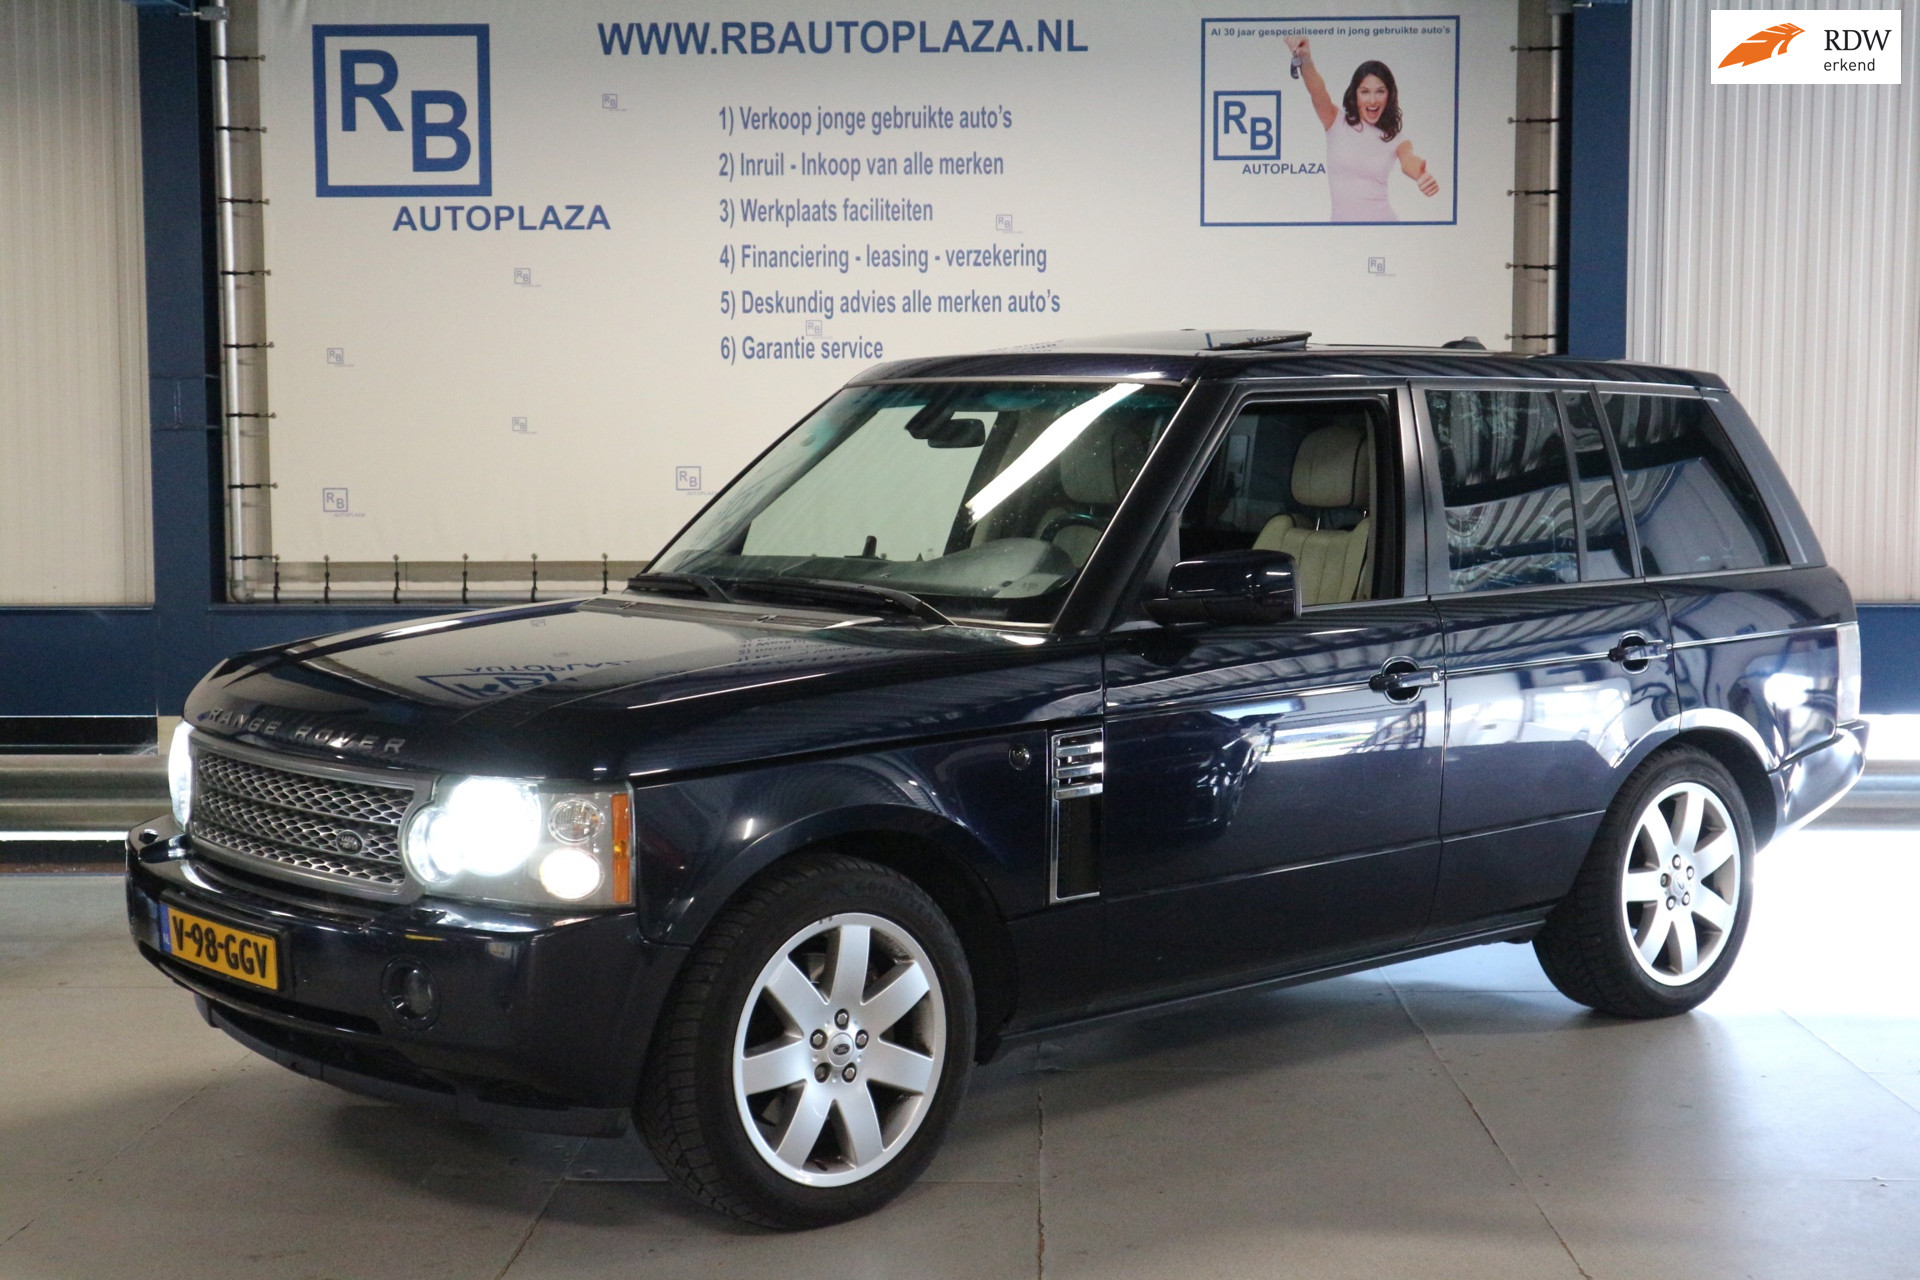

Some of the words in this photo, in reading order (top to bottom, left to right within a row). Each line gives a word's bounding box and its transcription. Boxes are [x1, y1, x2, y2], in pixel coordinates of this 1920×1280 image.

[597, 19, 1088, 55] WWW.RBAUTOPLAZA.NL
[1211, 28, 1221, 36] Al
[1223, 28, 1235, 36] 30
[1237, 28, 1255, 37] jaar
[1258, 27, 1334, 38] gespecialiseerd
[1337, 27, 1346, 35] in
[1348, 27, 1370, 36] jong
[1372, 25, 1418, 36] gebruikte
[1421, 25, 1451, 34] auto's
[340, 49, 471, 172] RB
[718, 106, 734, 136] 1)
[739, 106, 811, 135] Verkoop
[816, 106, 866, 135] jonge
[872, 105, 953, 135] gebruikte
[718, 152, 734, 182] 2)
[740, 152, 784, 176] Inruil
[801, 152, 861, 181] Inkoop
[866, 157, 898, 176] van
[903, 152, 933, 175] alle
[939, 151, 1004, 175] merken
[1242, 163, 1326, 174] AUTOPLAZA
[392, 205, 611, 232] AUTOPLAZA
[719, 199, 735, 229] 3)
[740, 198, 837, 227] Werkplaats
[843, 197, 933, 222] faciliteiten
[719, 245, 735, 274] 4)
[741, 244, 849, 273] Financiering
[866, 244, 928, 273] leasing
[945, 243, 1047, 273] verzekering
[720, 291, 735, 320] 5)
[741, 290, 834, 319] Deskundig
[840, 290, 896, 313] advies
[902, 289, 932, 313] alle
[938, 289, 1002, 312] merken
[720, 336, 737, 365] 6)
[741, 336, 815, 359] Garantie
[821, 336, 884, 359] service
[208, 708, 282, 735] RANGE
[295, 725, 405, 753] ROVER
[172, 915, 268, 979] V-98-GGV
